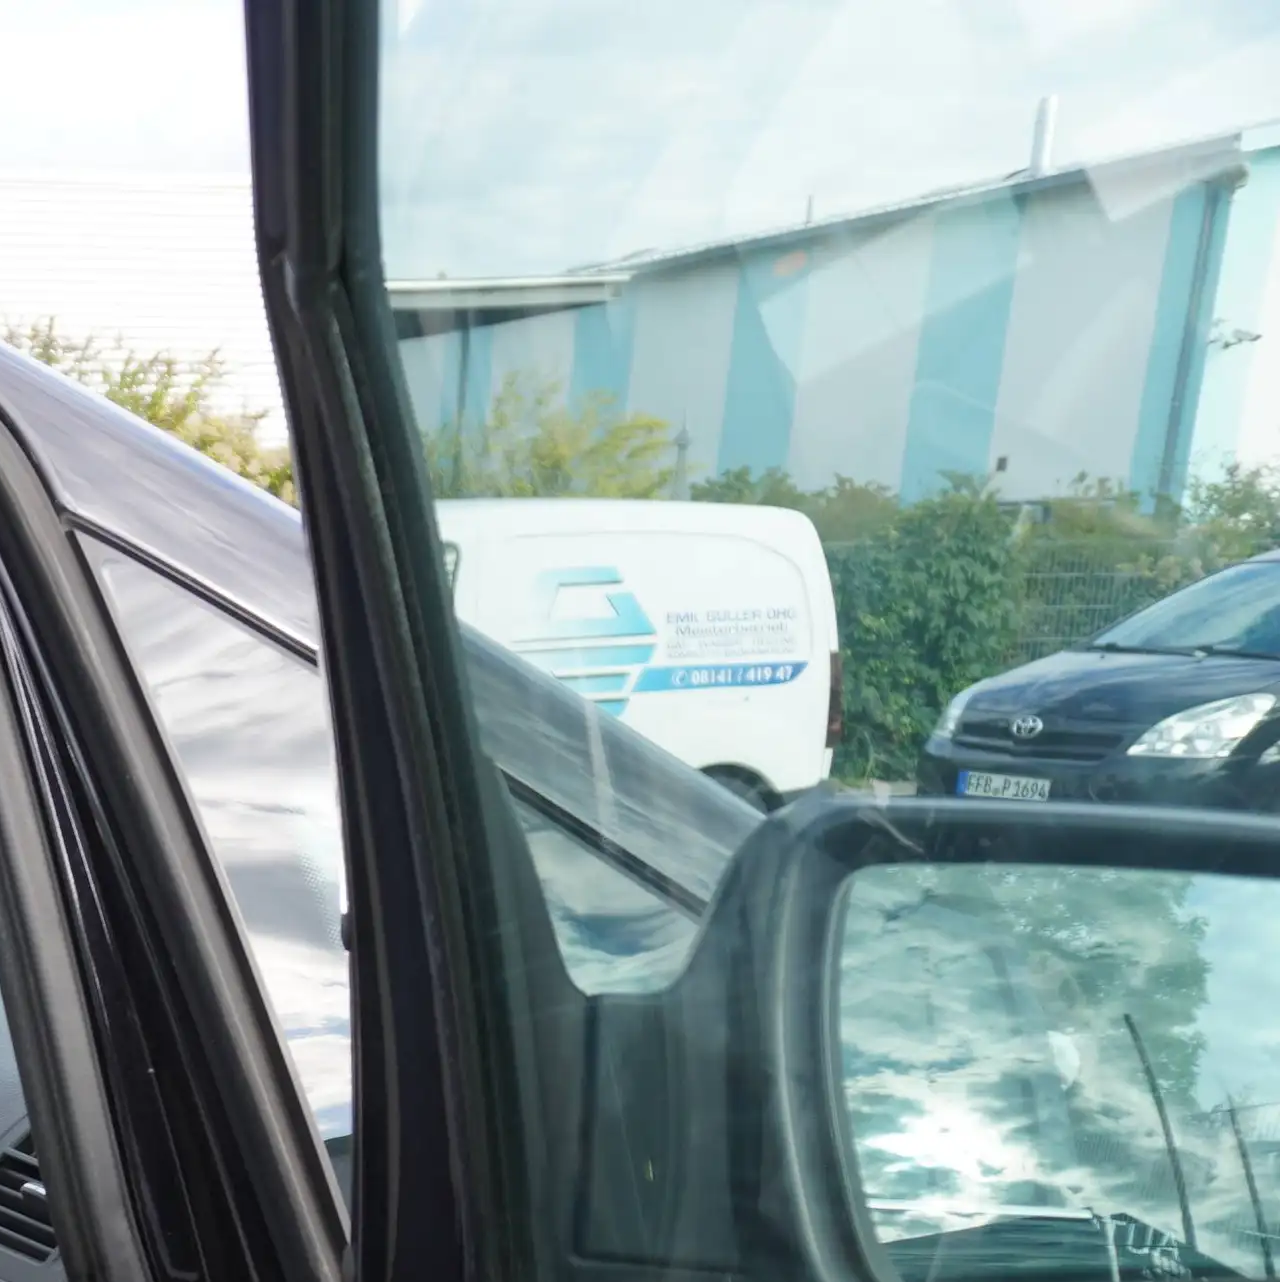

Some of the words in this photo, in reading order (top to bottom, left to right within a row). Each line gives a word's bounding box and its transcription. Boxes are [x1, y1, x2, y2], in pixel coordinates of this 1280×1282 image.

[691, 669, 733, 686] 08141
[746, 667, 773, 683] 419
[968, 773, 993, 794] FFB
